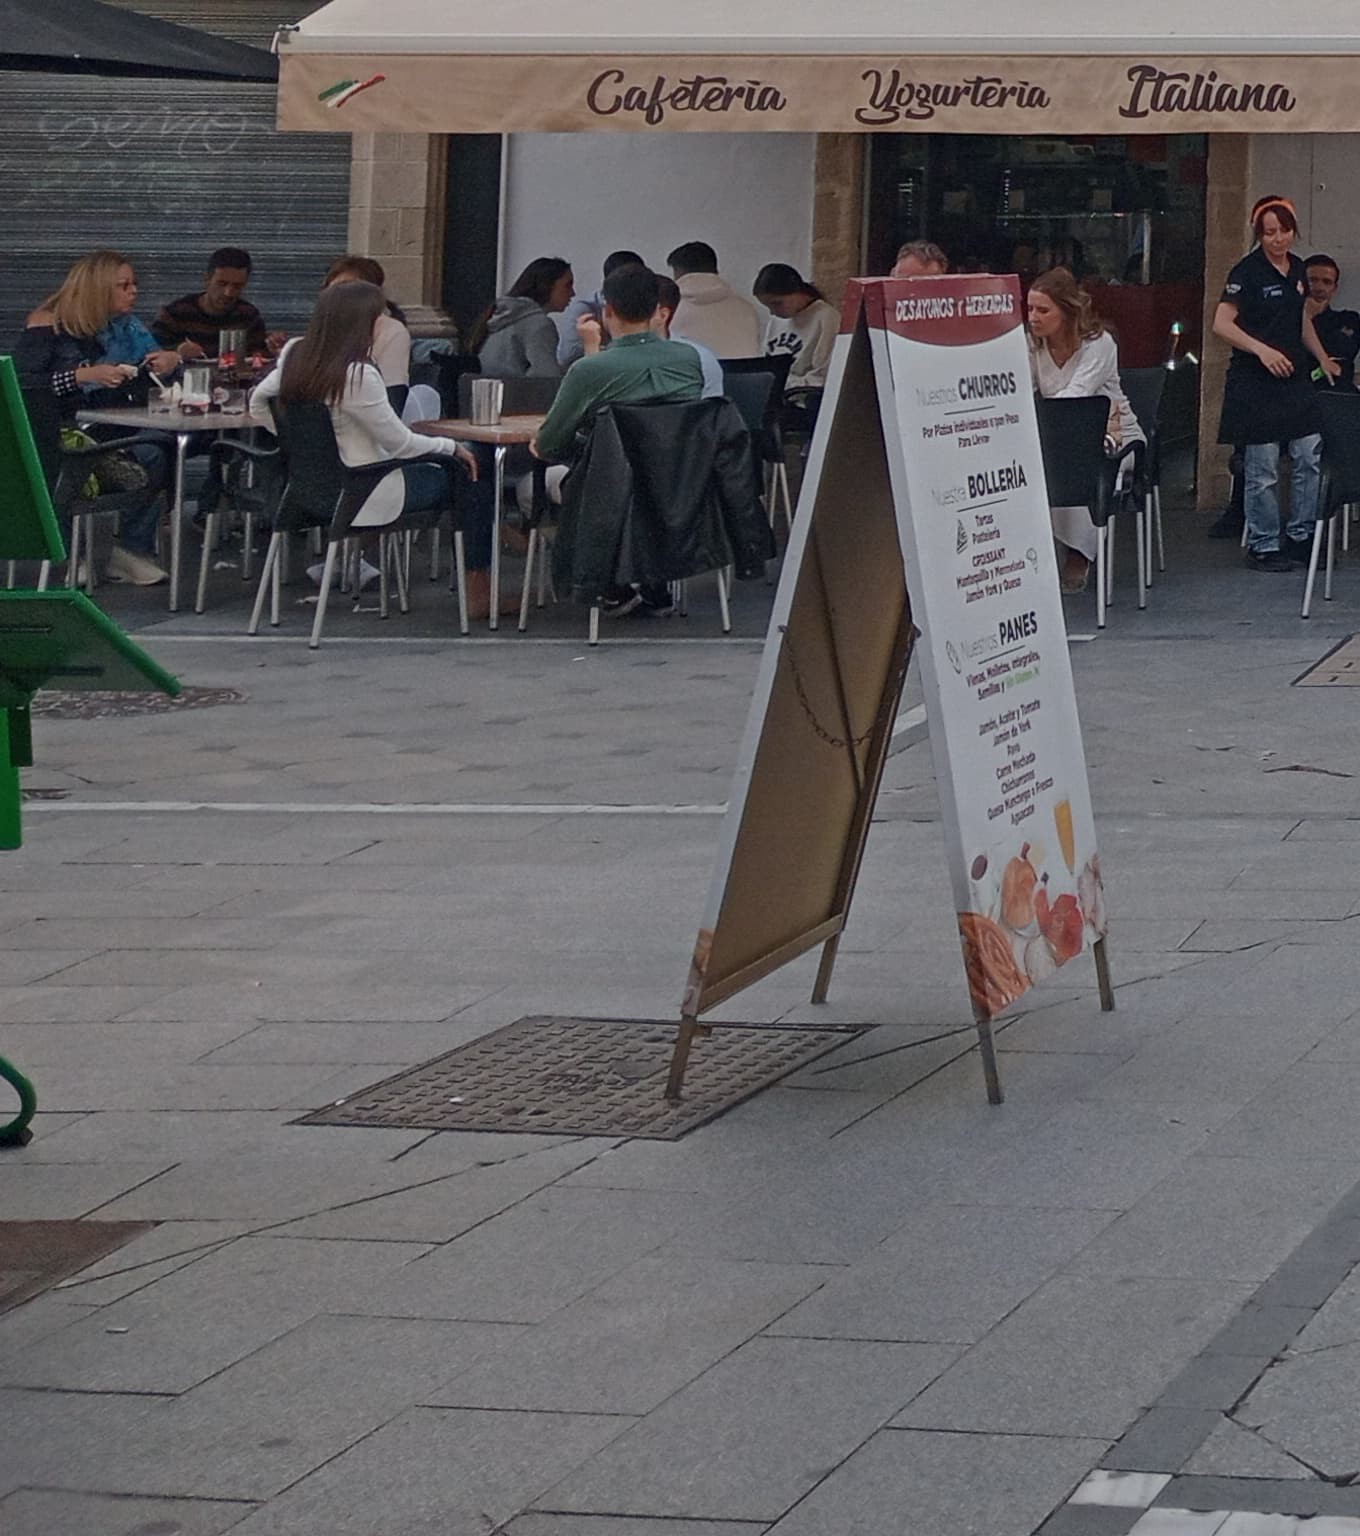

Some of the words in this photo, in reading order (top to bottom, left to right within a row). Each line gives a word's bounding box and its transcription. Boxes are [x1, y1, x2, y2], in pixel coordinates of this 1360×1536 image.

[1118, 64, 1296, 119] Italiana
[896, 297, 954, 322] DESAYUNOS
[958, 371, 1017, 400] CHURROS
[967, 458, 1028, 499] BOLLERÍA
[999, 611, 1038, 645] PANES
